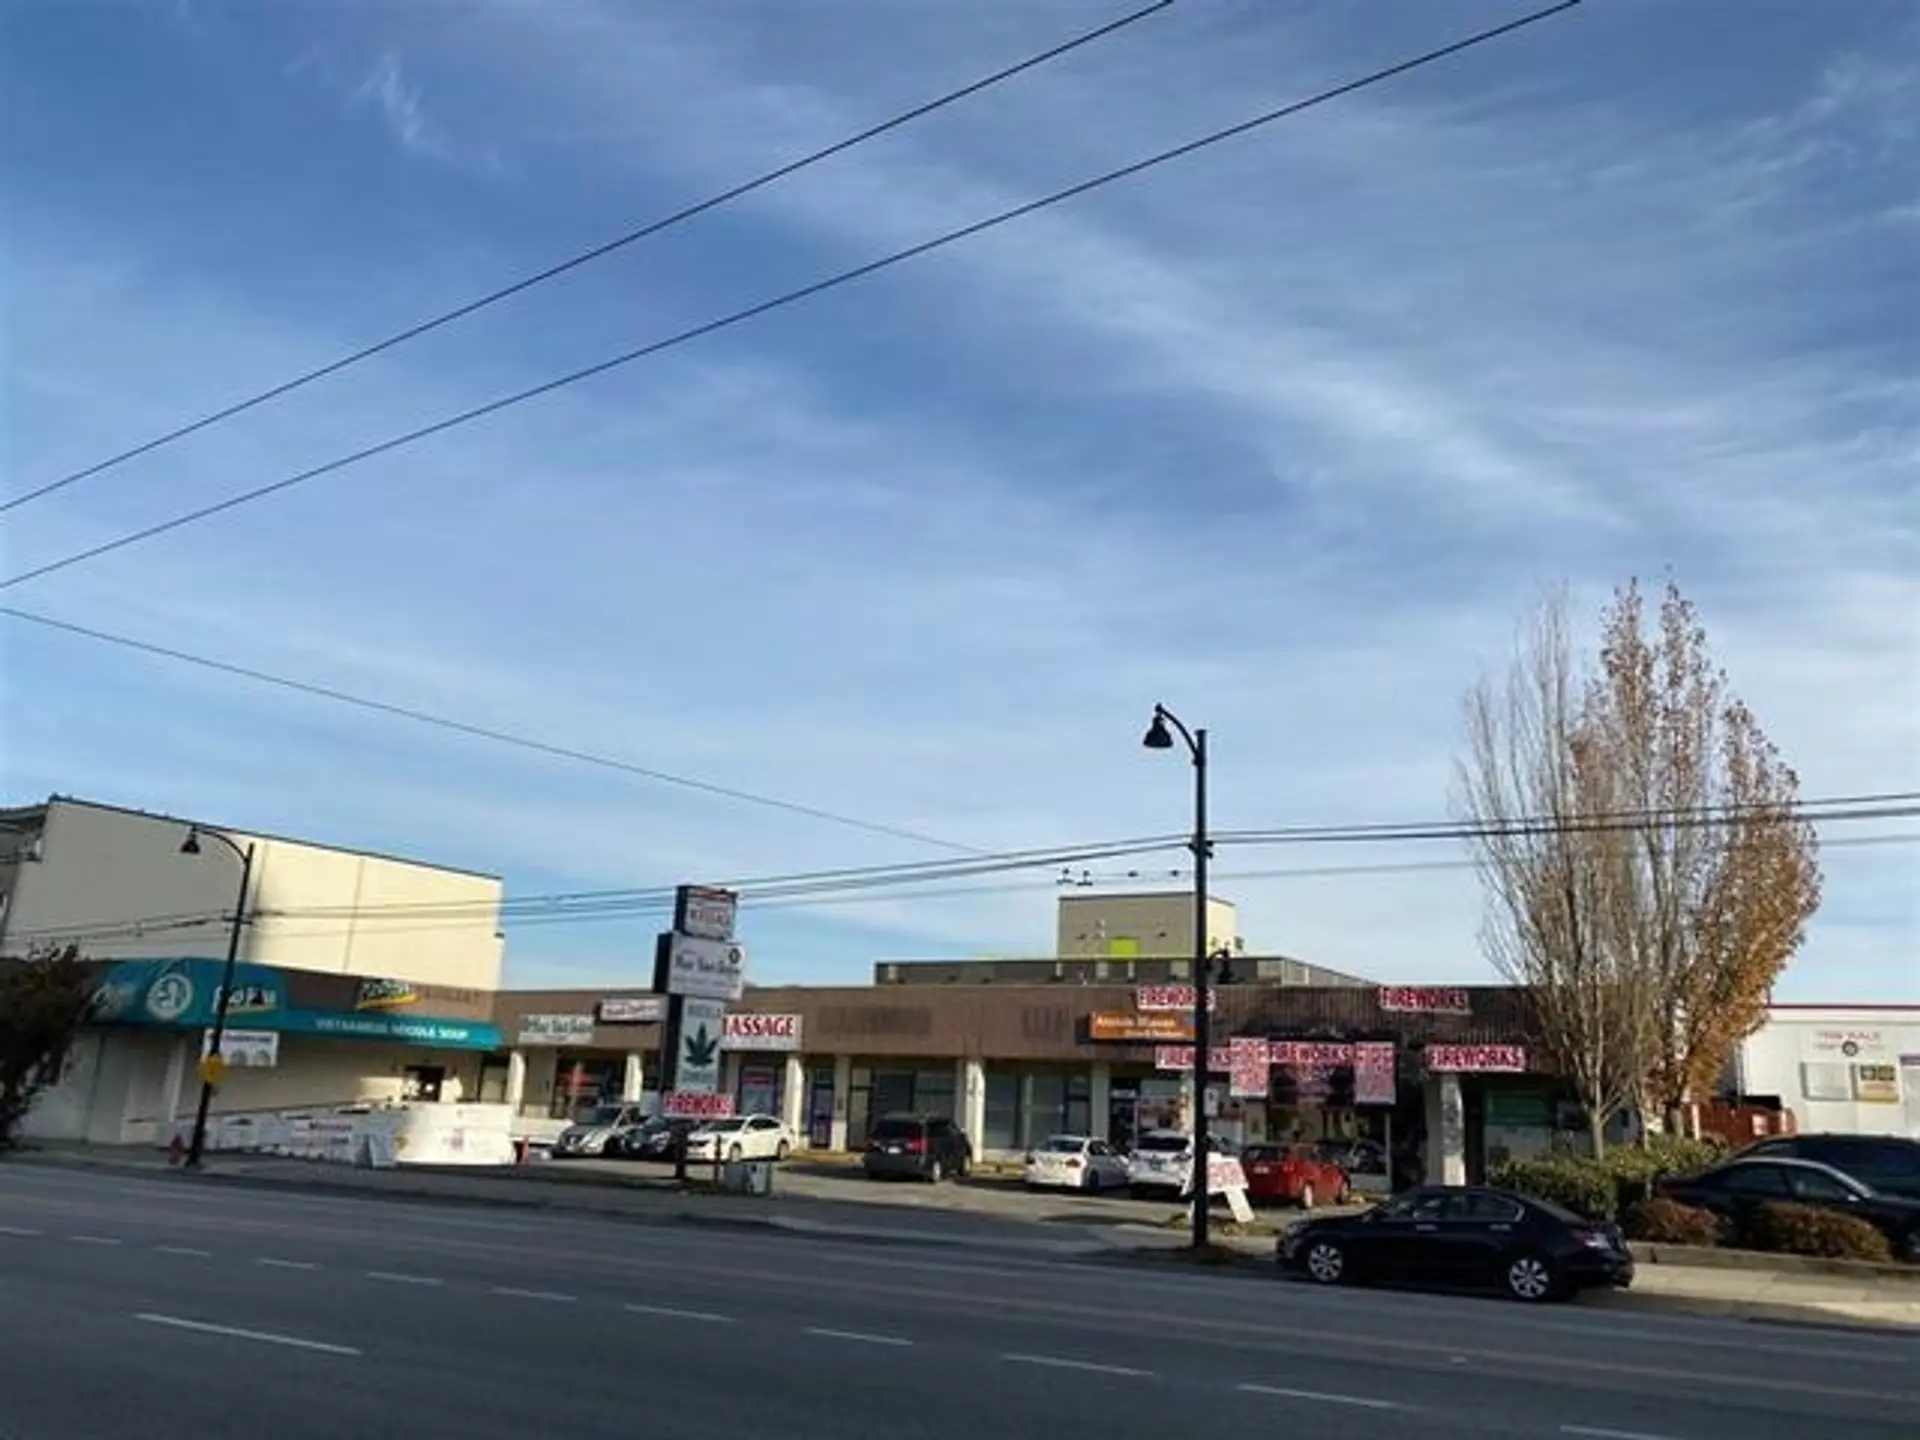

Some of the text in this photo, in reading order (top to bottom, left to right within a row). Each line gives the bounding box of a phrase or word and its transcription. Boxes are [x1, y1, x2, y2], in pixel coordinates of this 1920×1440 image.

[1139, 985, 1214, 1008] FIREWORS
[1385, 986, 1466, 1010] FIREWORKS
[438, 1026, 469, 1040] SOUP
[1268, 1042, 1353, 1066] FIREWORKS
[1429, 1046, 1521, 1069] FIREWORKS
